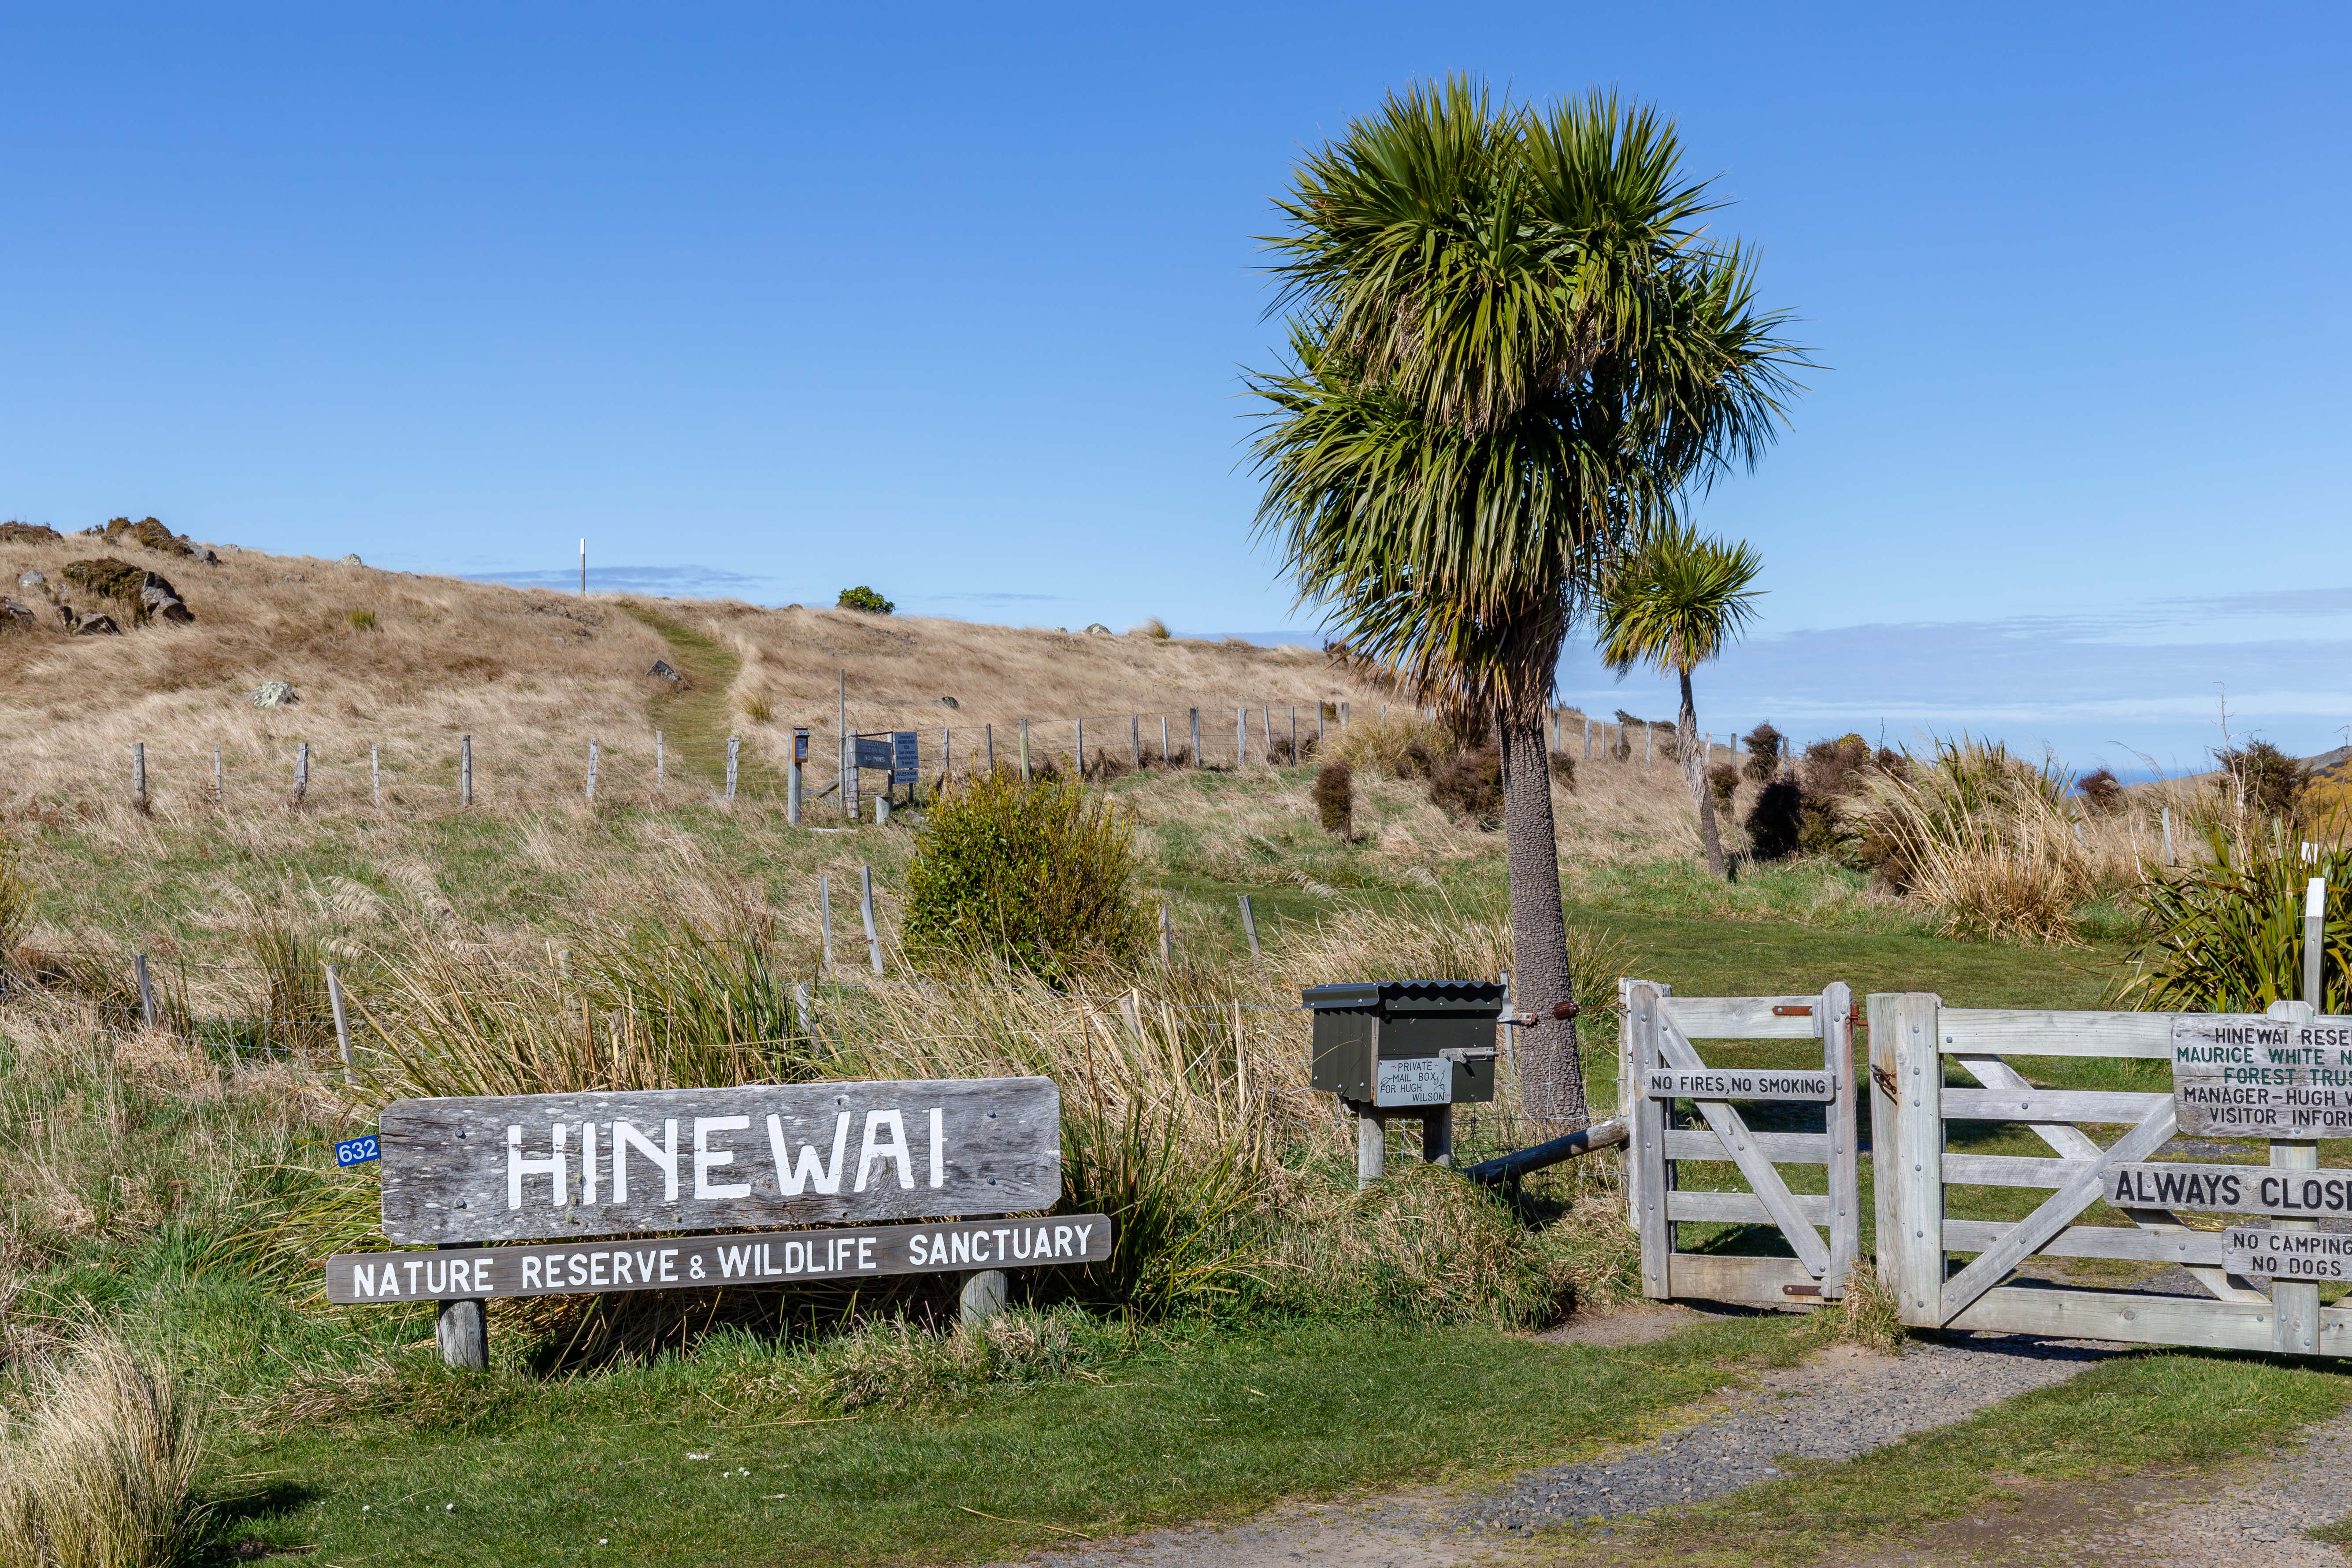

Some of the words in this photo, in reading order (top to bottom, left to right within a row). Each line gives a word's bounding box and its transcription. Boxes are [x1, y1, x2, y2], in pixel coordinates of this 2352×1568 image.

[857, 740, 890, 749] WOODCUTTERS
[2301, 1030, 2352, 1045] RESE
[2178, 1047, 2254, 1064] MAURICE
[2268, 1048, 2325, 1065] WHITE
[1398, 1061, 1432, 1071] PRIVATE
[1393, 1073, 1411, 1082] MAIL
[1419, 1072, 1436, 1081] BOX
[1651, 1076, 1672, 1090] NO
[1759, 1079, 1825, 1094] SMOKING
[2224, 1068, 2296, 1085] FOREST
[1380, 1085, 1396, 1094] FOR
[1400, 1083, 1422, 1093] HUGH
[1412, 1092, 1446, 1102] WILSON
[2210, 1108, 2276, 1124] VISITOR
[339, 1139, 378, 1162] 632
[2115, 1171, 2241, 1205] ALWAYS
[2234, 1233, 2258, 1249] NO
[2270, 1235, 2352, 1255] CAMPING
[353, 1257, 495, 1298] NATURE
[522, 1248, 679, 1290] RESERVE
[689, 1256, 707, 1280] &
[716, 1237, 877, 1279] WILDLIFE
[909, 1223, 1093, 1265] SANCTUARY
[2252, 1256, 2277, 1272] NO
[2289, 1258, 2341, 1277] DOGS
